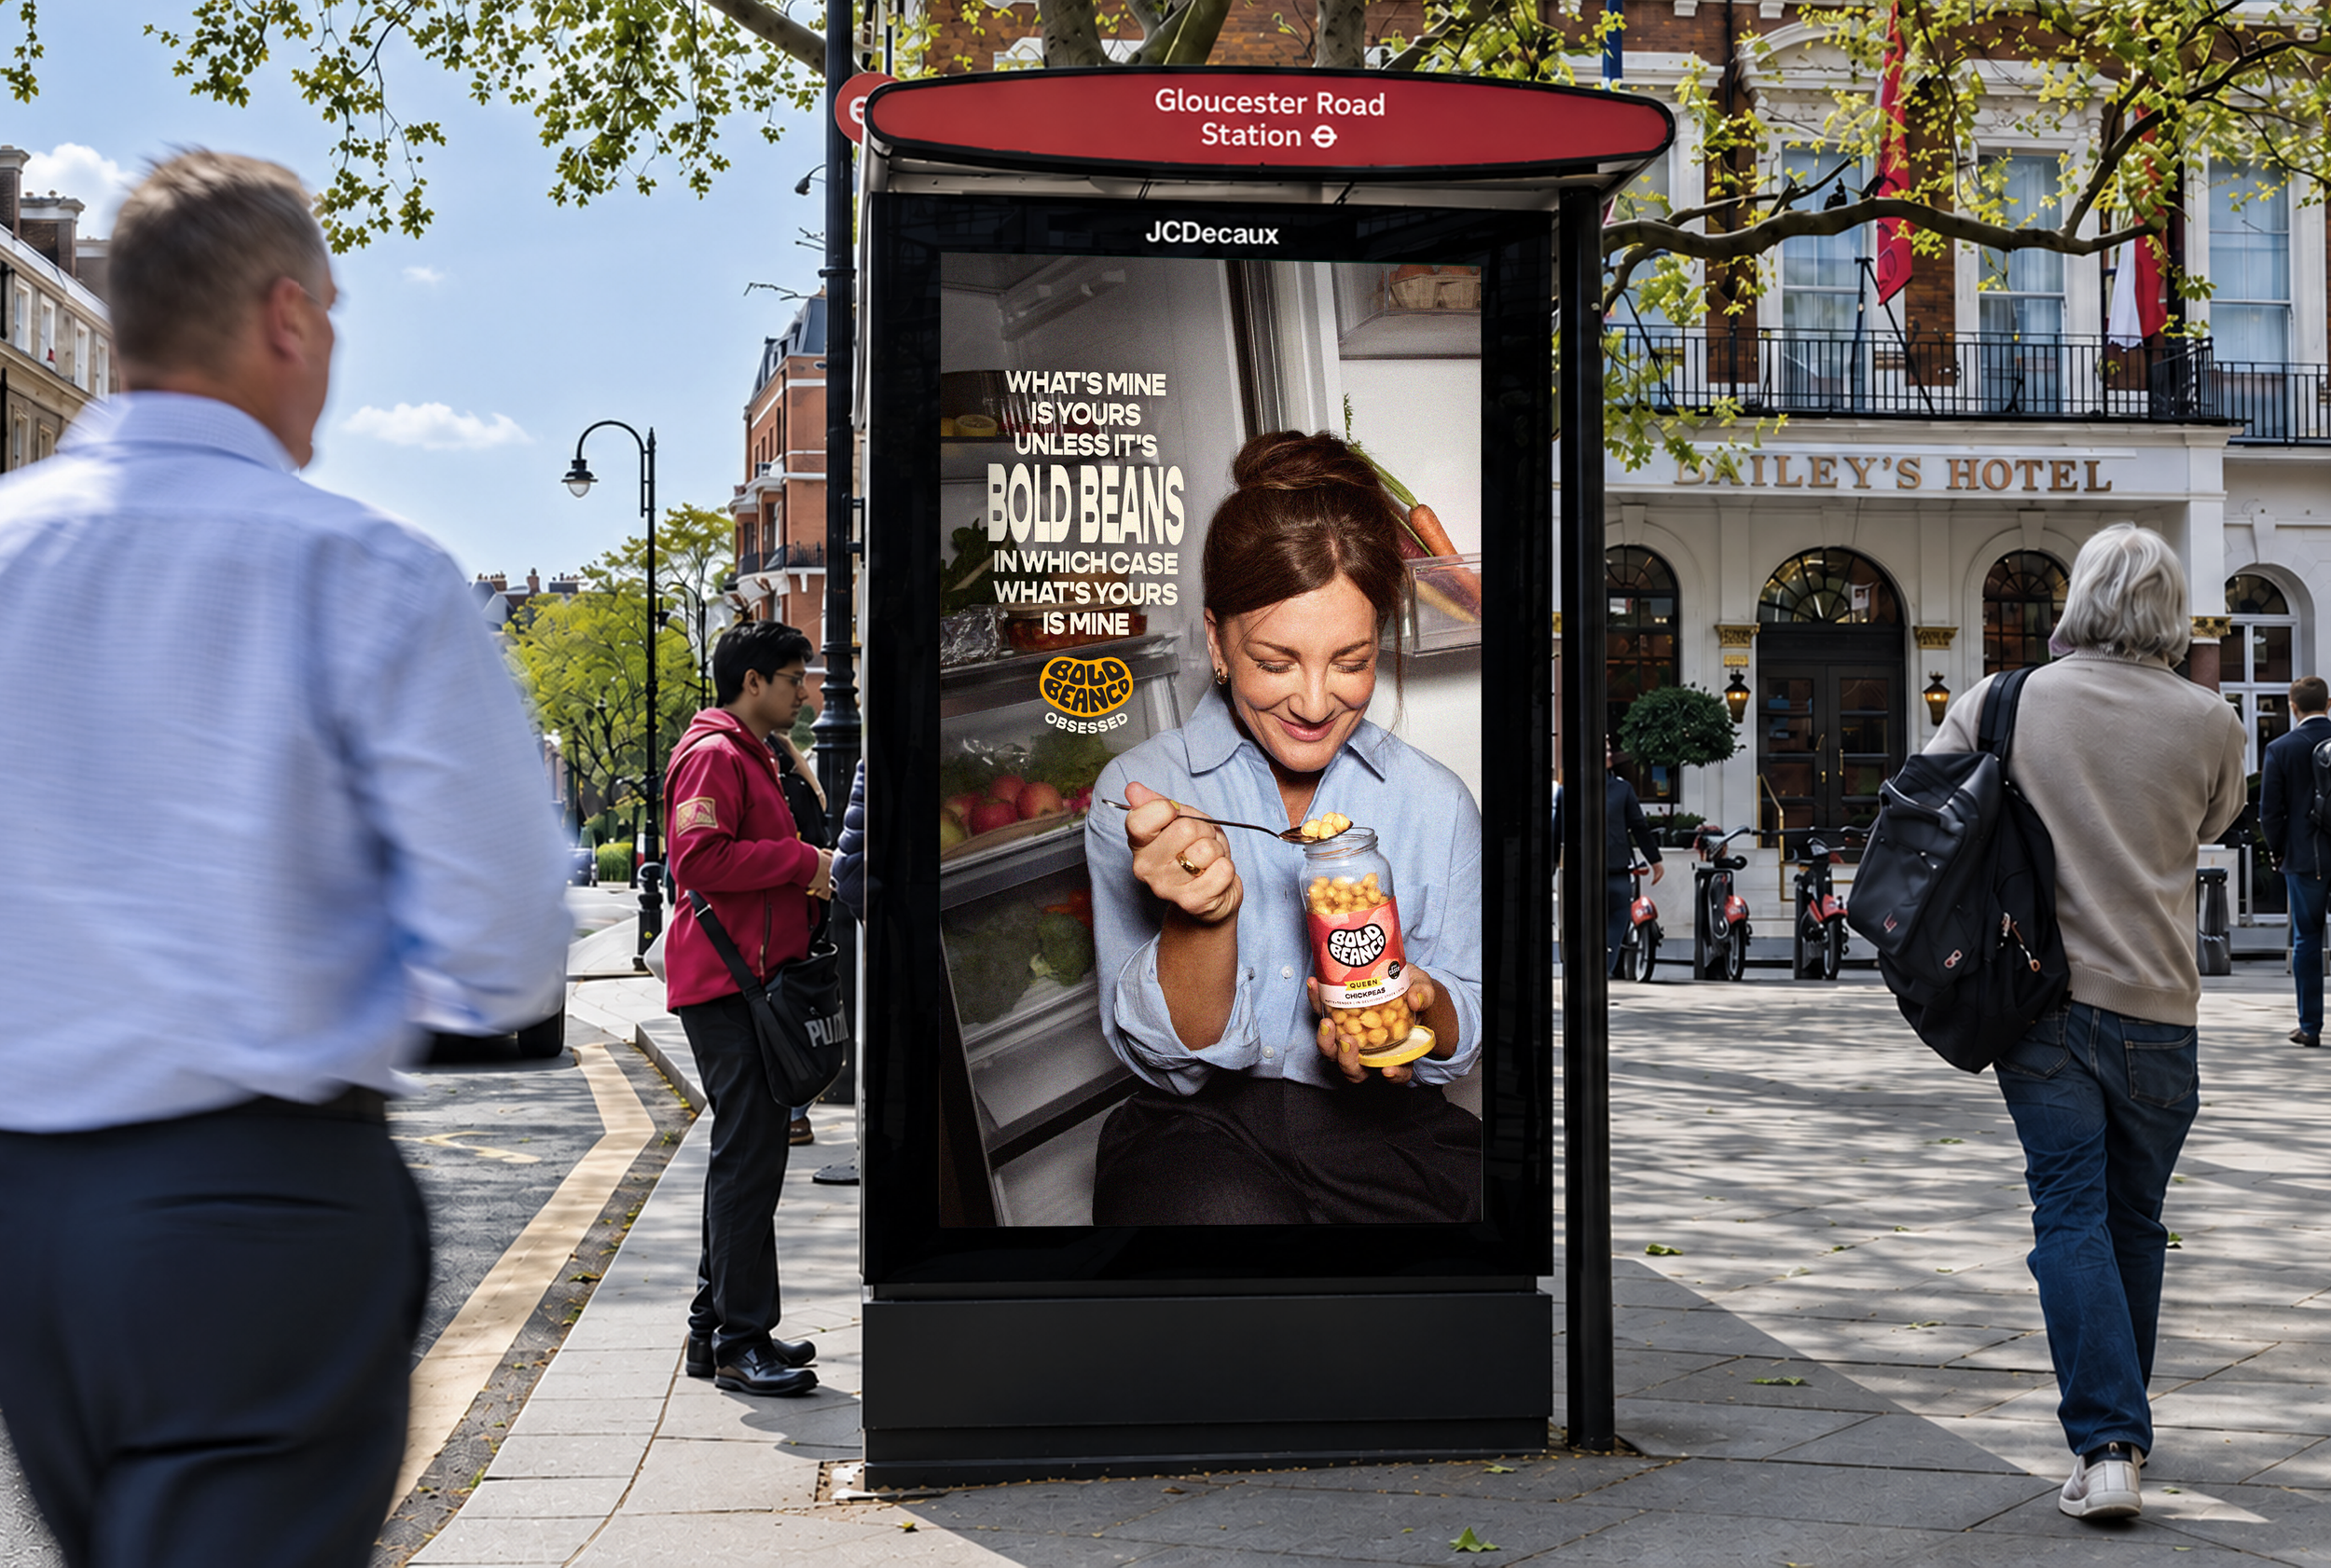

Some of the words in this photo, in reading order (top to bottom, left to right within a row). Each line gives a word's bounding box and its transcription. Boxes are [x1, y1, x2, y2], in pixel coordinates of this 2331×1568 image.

[1155, 88, 1308, 114] Gloucester
[1317, 91, 1386, 117] Road
[1202, 122, 1303, 146] Station
[1146, 220, 1279, 245] JCDecaux
[1005, 370, 1103, 395] WHAT'S
[1107, 372, 1166, 396] MINE
[1031, 401, 1055, 425] IS
[1055, 401, 1141, 427] YOURS
[1014, 432, 1110, 457] UNLESS
[1114, 433, 1159, 458] IT'S
[1946, 458, 2113, 492] HOTEL
[987, 462, 1072, 543] BOLD
[1080, 464, 1185, 546] BEANS
[994, 550, 1017, 572] IN
[1020, 550, 1107, 574] WHICH
[1110, 551, 1179, 575] CASE
[993, 580, 1091, 605] WHAT'S
[1093, 582, 1179, 606] YOURS
[1043, 612, 1065, 635] IS
[1069, 612, 1129, 636] MINE
[1048, 660, 1125, 686] BOLD
[1044, 711, 1128, 735] OBSESSED
[1331, 926, 1380, 947] BOLD
[1345, 987, 1386, 999] CHICKPEAS
[1349, 979, 1378, 988] QUEEN
